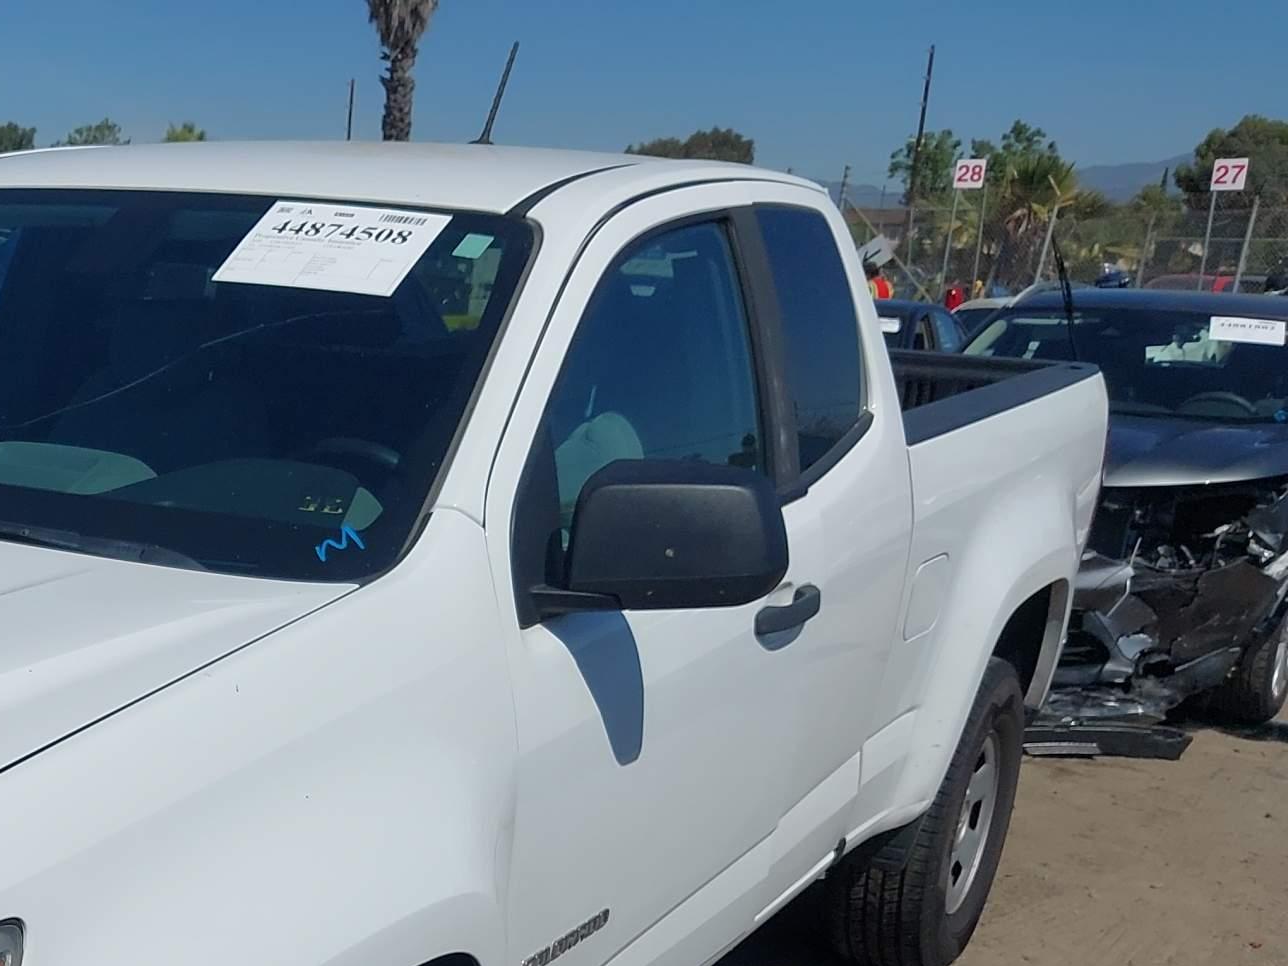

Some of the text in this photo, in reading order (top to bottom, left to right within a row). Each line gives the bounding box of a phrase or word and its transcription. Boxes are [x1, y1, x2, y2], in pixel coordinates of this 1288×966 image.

[956, 165, 983, 183] 28
[1214, 165, 1246, 184] 27
[272, 219, 413, 245] 44874508
